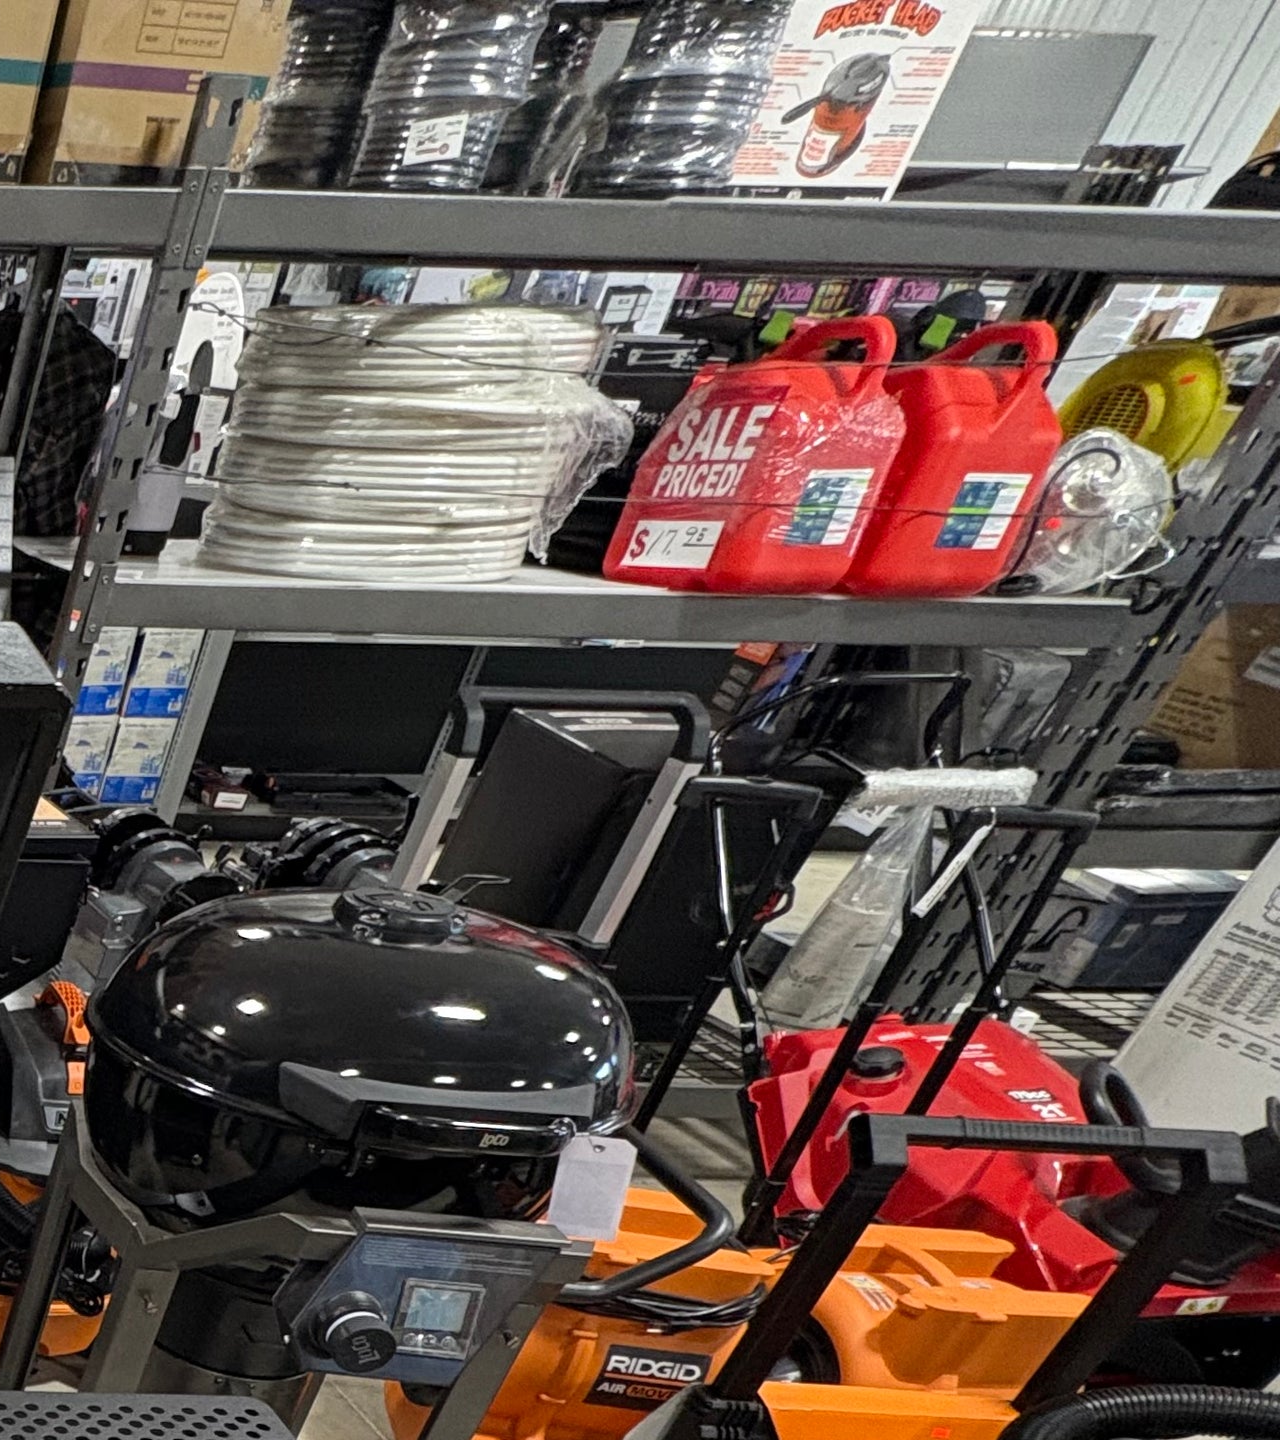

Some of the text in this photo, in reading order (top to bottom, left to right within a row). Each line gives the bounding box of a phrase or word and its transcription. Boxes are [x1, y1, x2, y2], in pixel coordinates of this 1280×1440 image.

[813, 0, 942, 40] BUCKET HEAD
[667, 404, 777, 463] SALE
[651, 461, 748, 498] PRICED!
[606, 1355, 702, 1382] RIDGID
[596, 1381, 678, 1399] AIR MOVE
